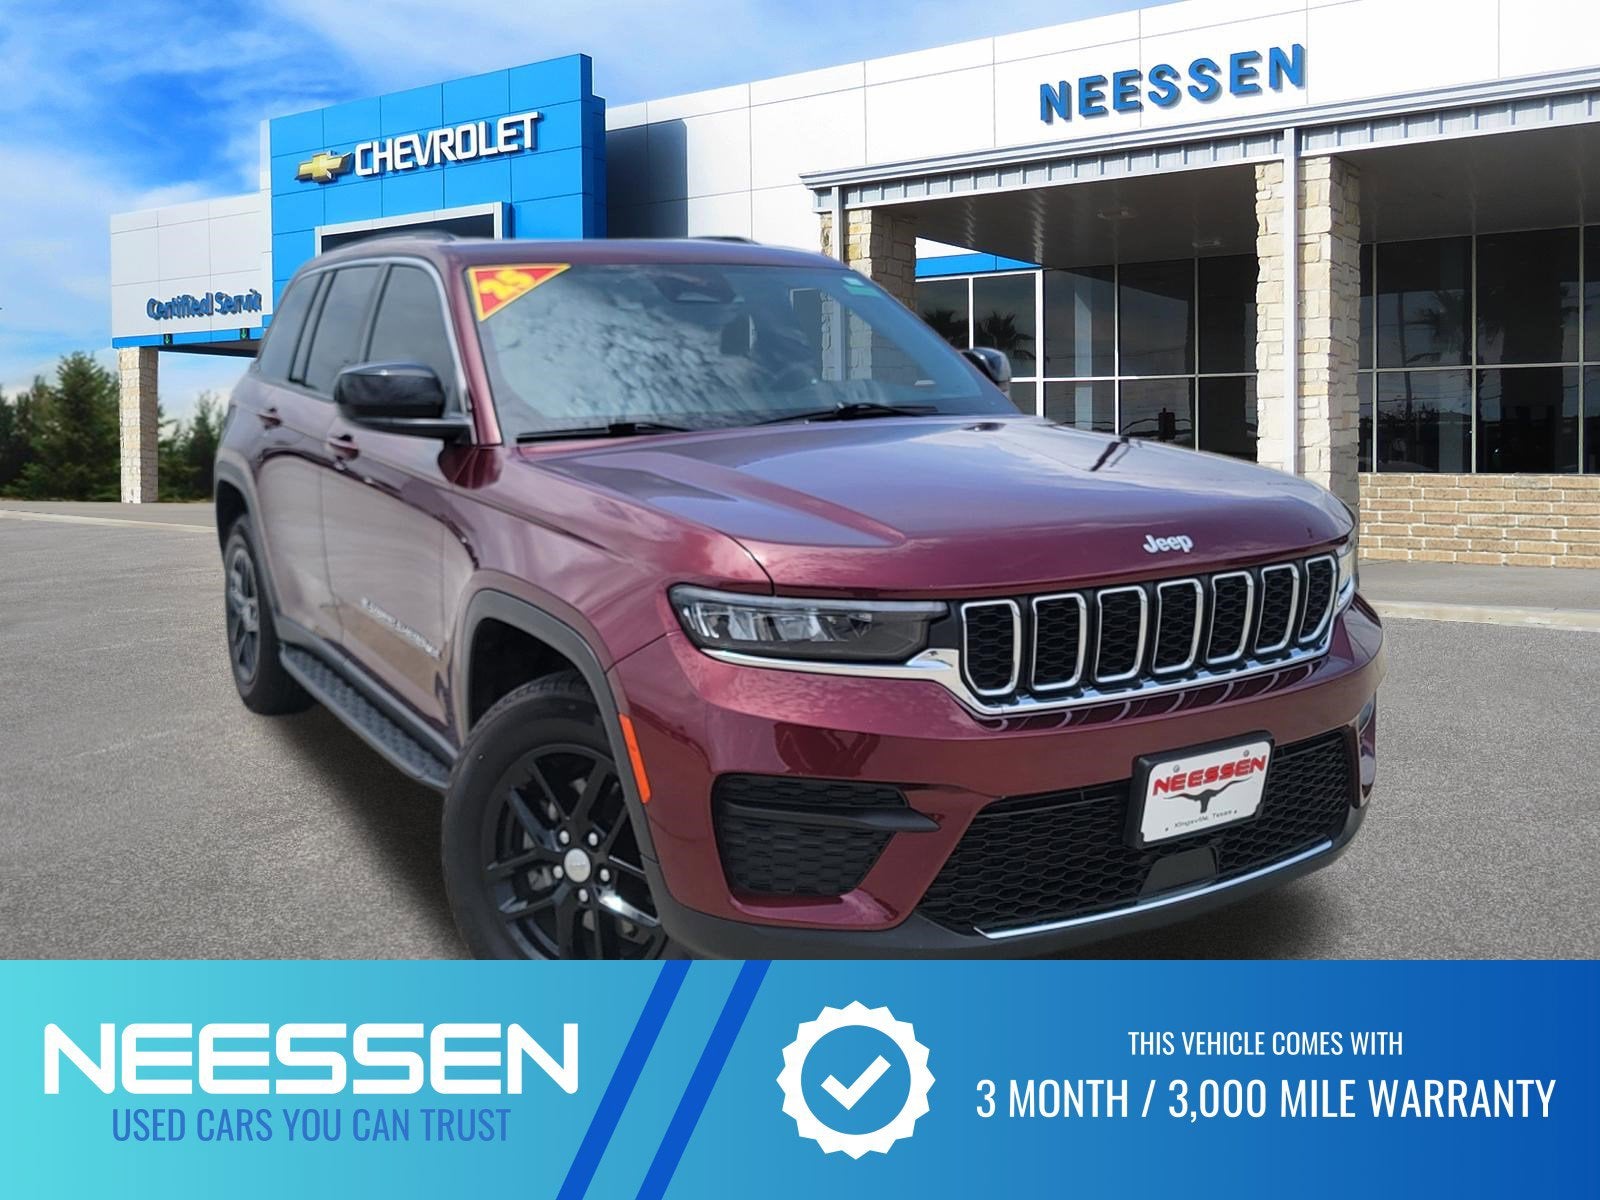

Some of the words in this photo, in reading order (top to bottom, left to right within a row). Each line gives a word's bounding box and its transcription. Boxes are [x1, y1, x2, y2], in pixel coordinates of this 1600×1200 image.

[1040, 43, 1305, 124] NEESSEN
[354, 111, 543, 177] CHEVROLET
[147, 292, 213, 320] Certified
[1143, 534, 1193, 553] Jeep
[1153, 755, 1266, 796] NEESSEN
